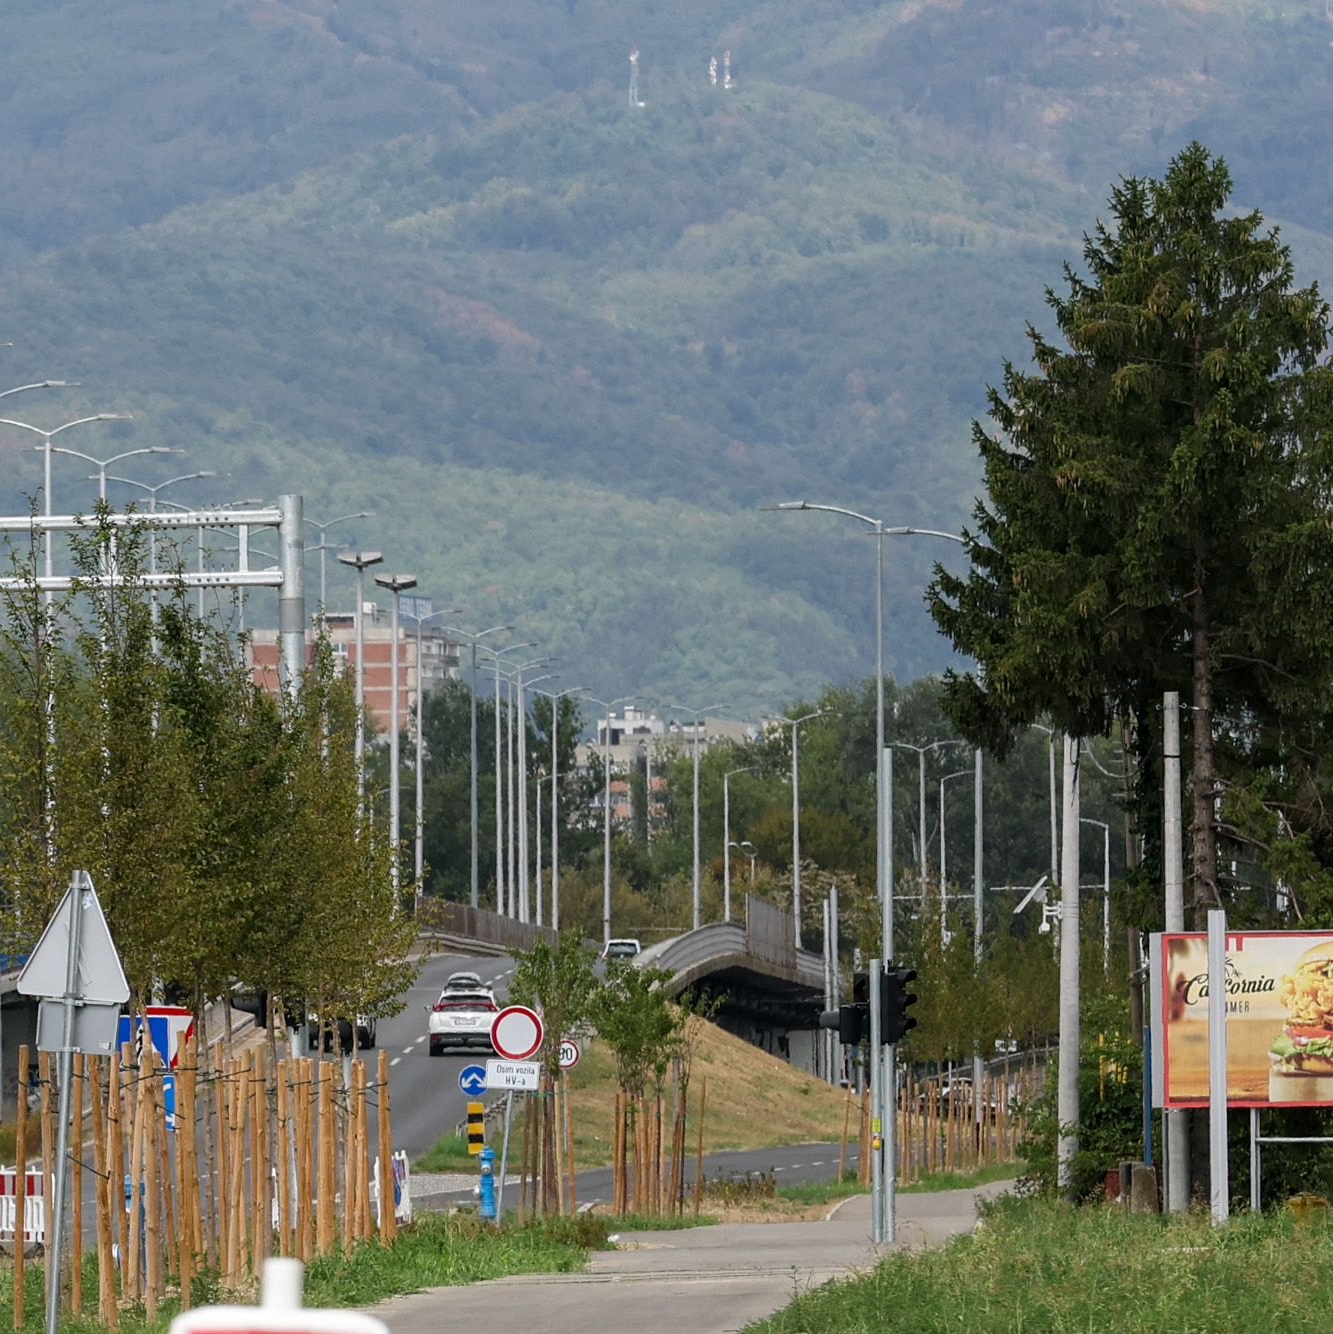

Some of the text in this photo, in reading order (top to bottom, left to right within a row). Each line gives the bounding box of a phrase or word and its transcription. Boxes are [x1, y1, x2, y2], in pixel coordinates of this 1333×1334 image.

[1176, 973, 1275, 1005] Caornia
[496, 1064, 535, 1075] Osim vozila
[505, 1076, 526, 1086] HV-a
